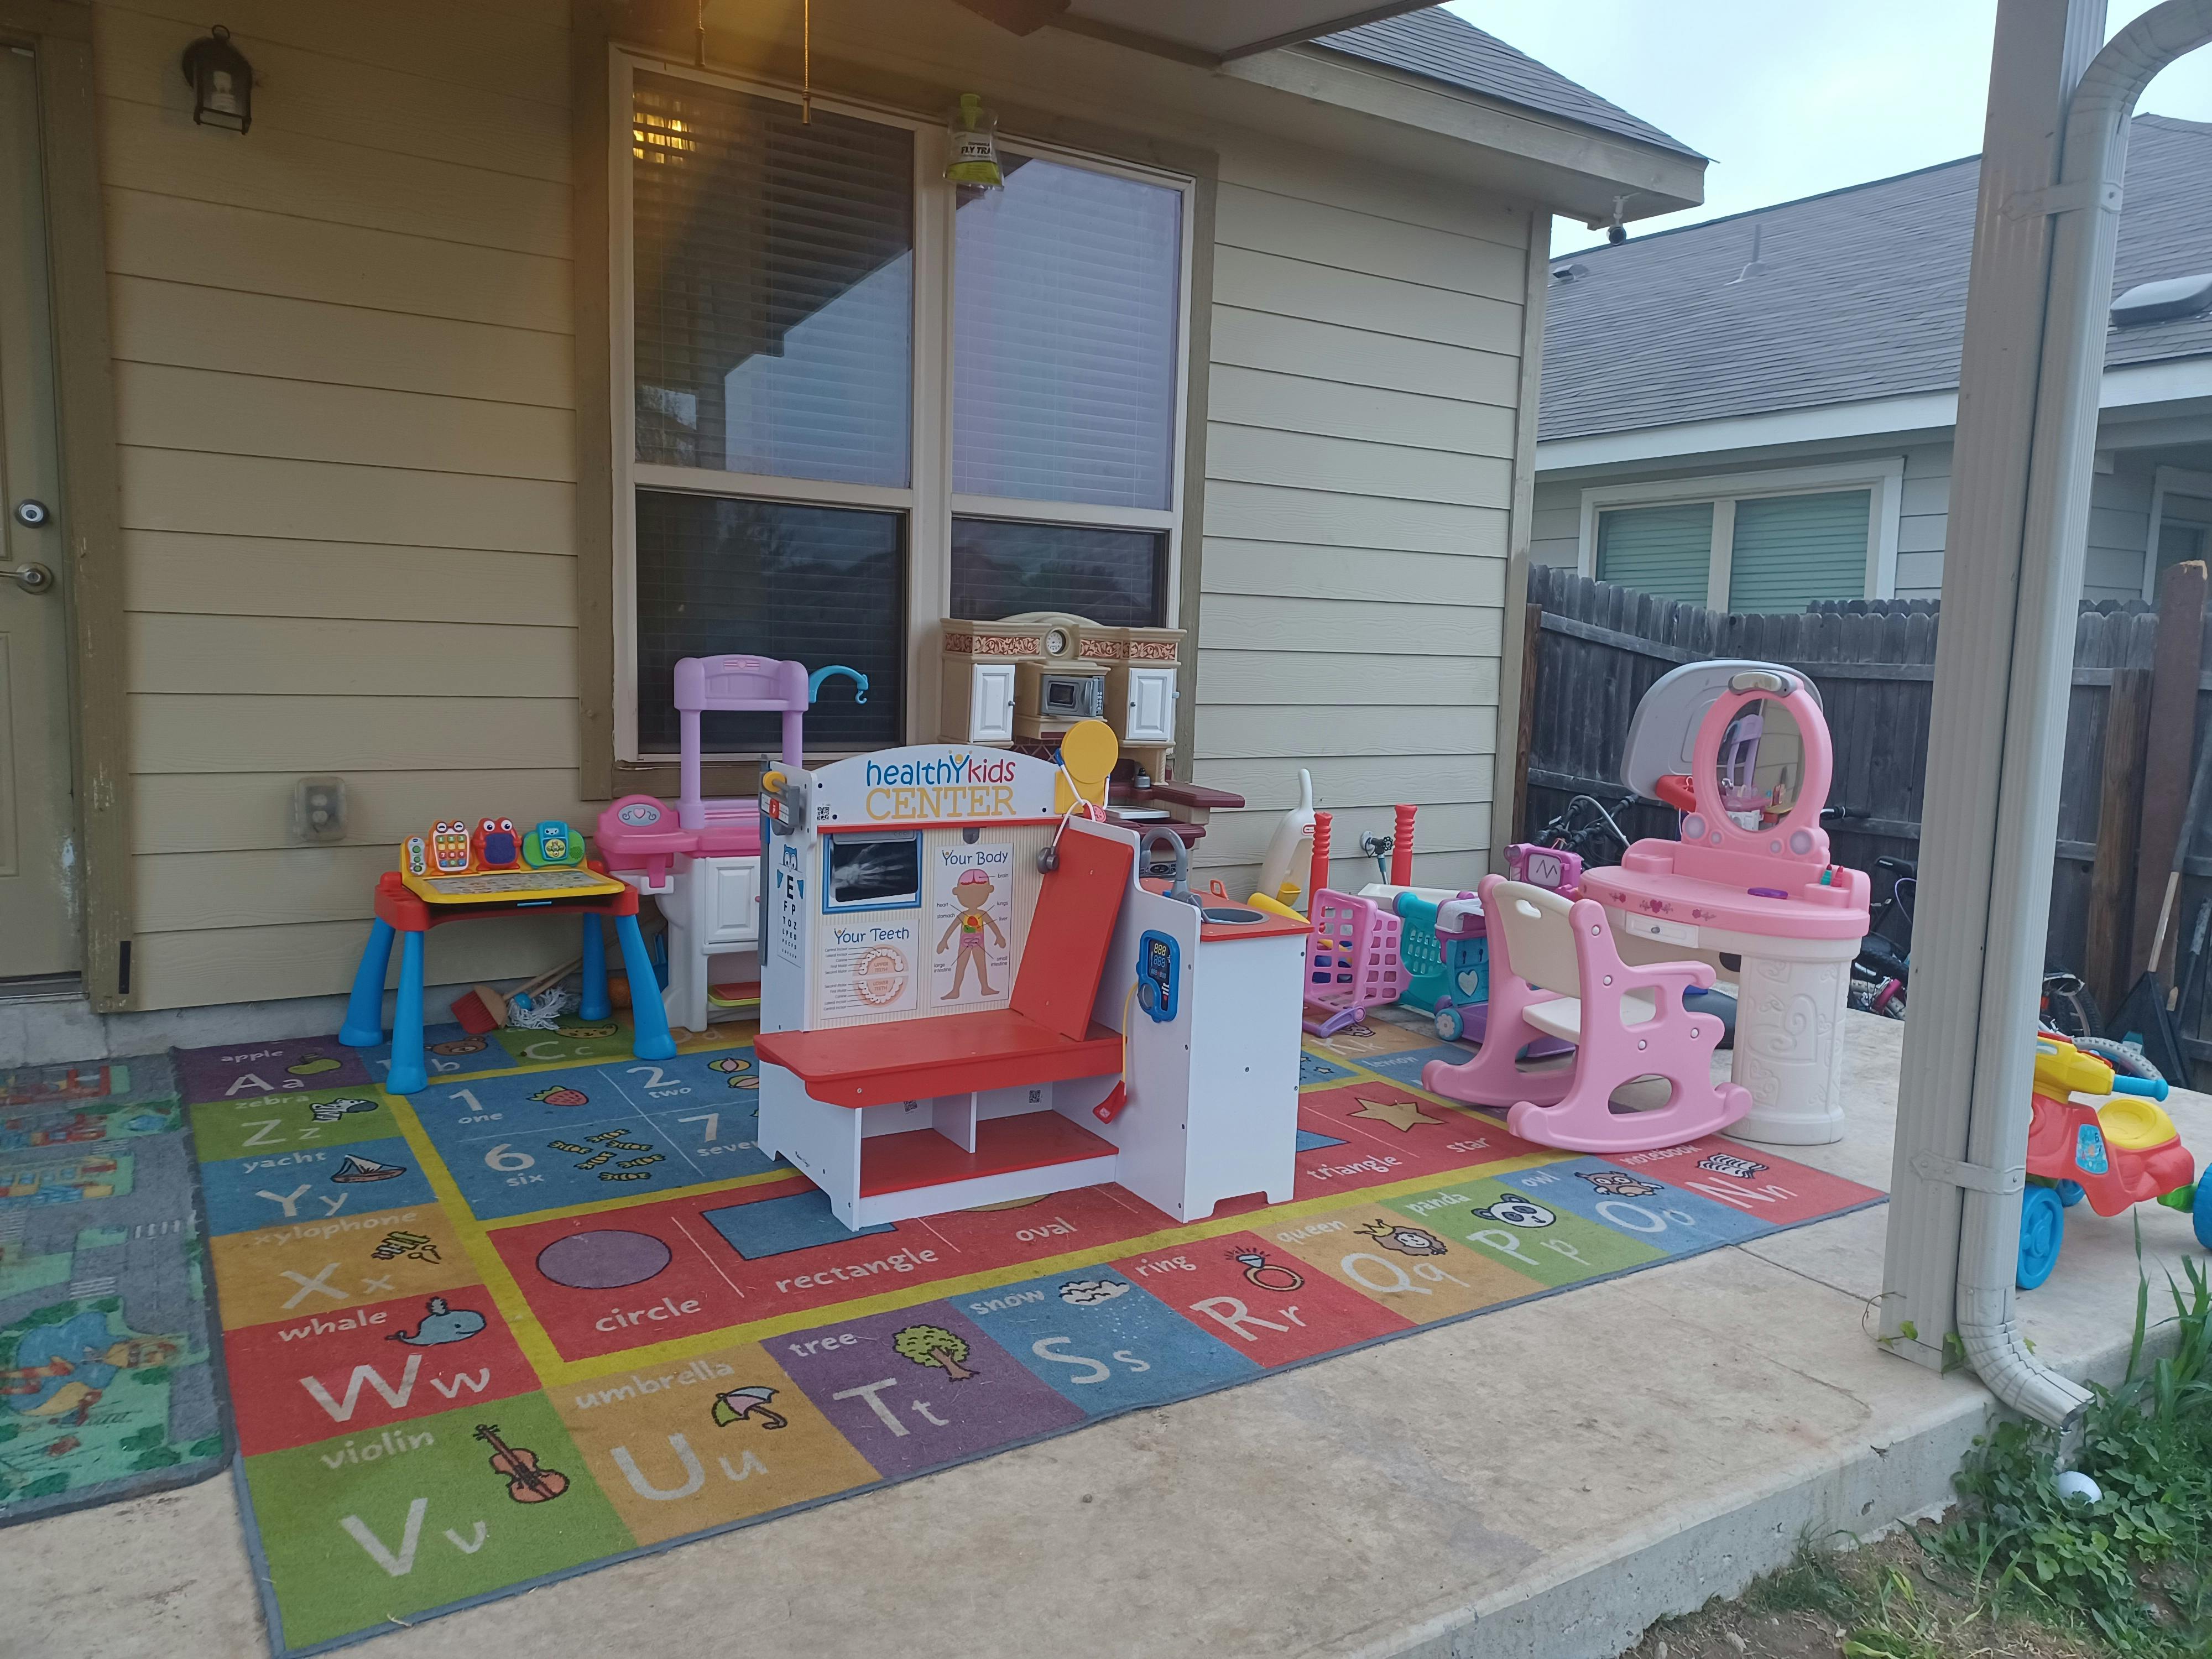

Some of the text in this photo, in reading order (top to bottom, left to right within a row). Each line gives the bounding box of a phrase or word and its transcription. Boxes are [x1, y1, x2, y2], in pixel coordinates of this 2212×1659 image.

[866, 786, 1016, 820] CENTER
[942, 849, 1008, 866] Your Body
[786, 875, 794, 900] E
[834, 927, 909, 945] Your Teeth
[221, 1050, 284, 1063] apple
[1361, 1056, 1419, 1068] lemon
[626, 1066, 681, 1088] 2
[235, 1093, 310, 1109] zebra
[448, 1088, 483, 1112] 1
[648, 1086, 692, 1099] two
[458, 1111, 503, 1124] one
[677, 1113, 719, 1142] 7
[484, 1144, 535, 1171] 6
[1446, 1138, 1490, 1154] star
[242, 1150, 327, 1174] yacht
[1307, 1155, 1403, 1180] triangle
[505, 1171, 545, 1187] six
[1521, 1170, 1561, 1187] owl
[1405, 1192, 1473, 1214] panda
[254, 1211, 418, 1246] xylophone
[1015, 1217, 1077, 1242] oval
[1276, 1219, 1348, 1244] queen
[775, 1248, 938, 1293] rectangle
[1135, 1254, 1196, 1277] ring
[969, 1288, 1045, 1315] snow
[278, 1309, 387, 1342] whale
[594, 1297, 701, 1332] circle
[787, 1331, 858, 1357] tree
[576, 1360, 735, 1410] umbrella
[321, 1429, 435, 1469] violin
